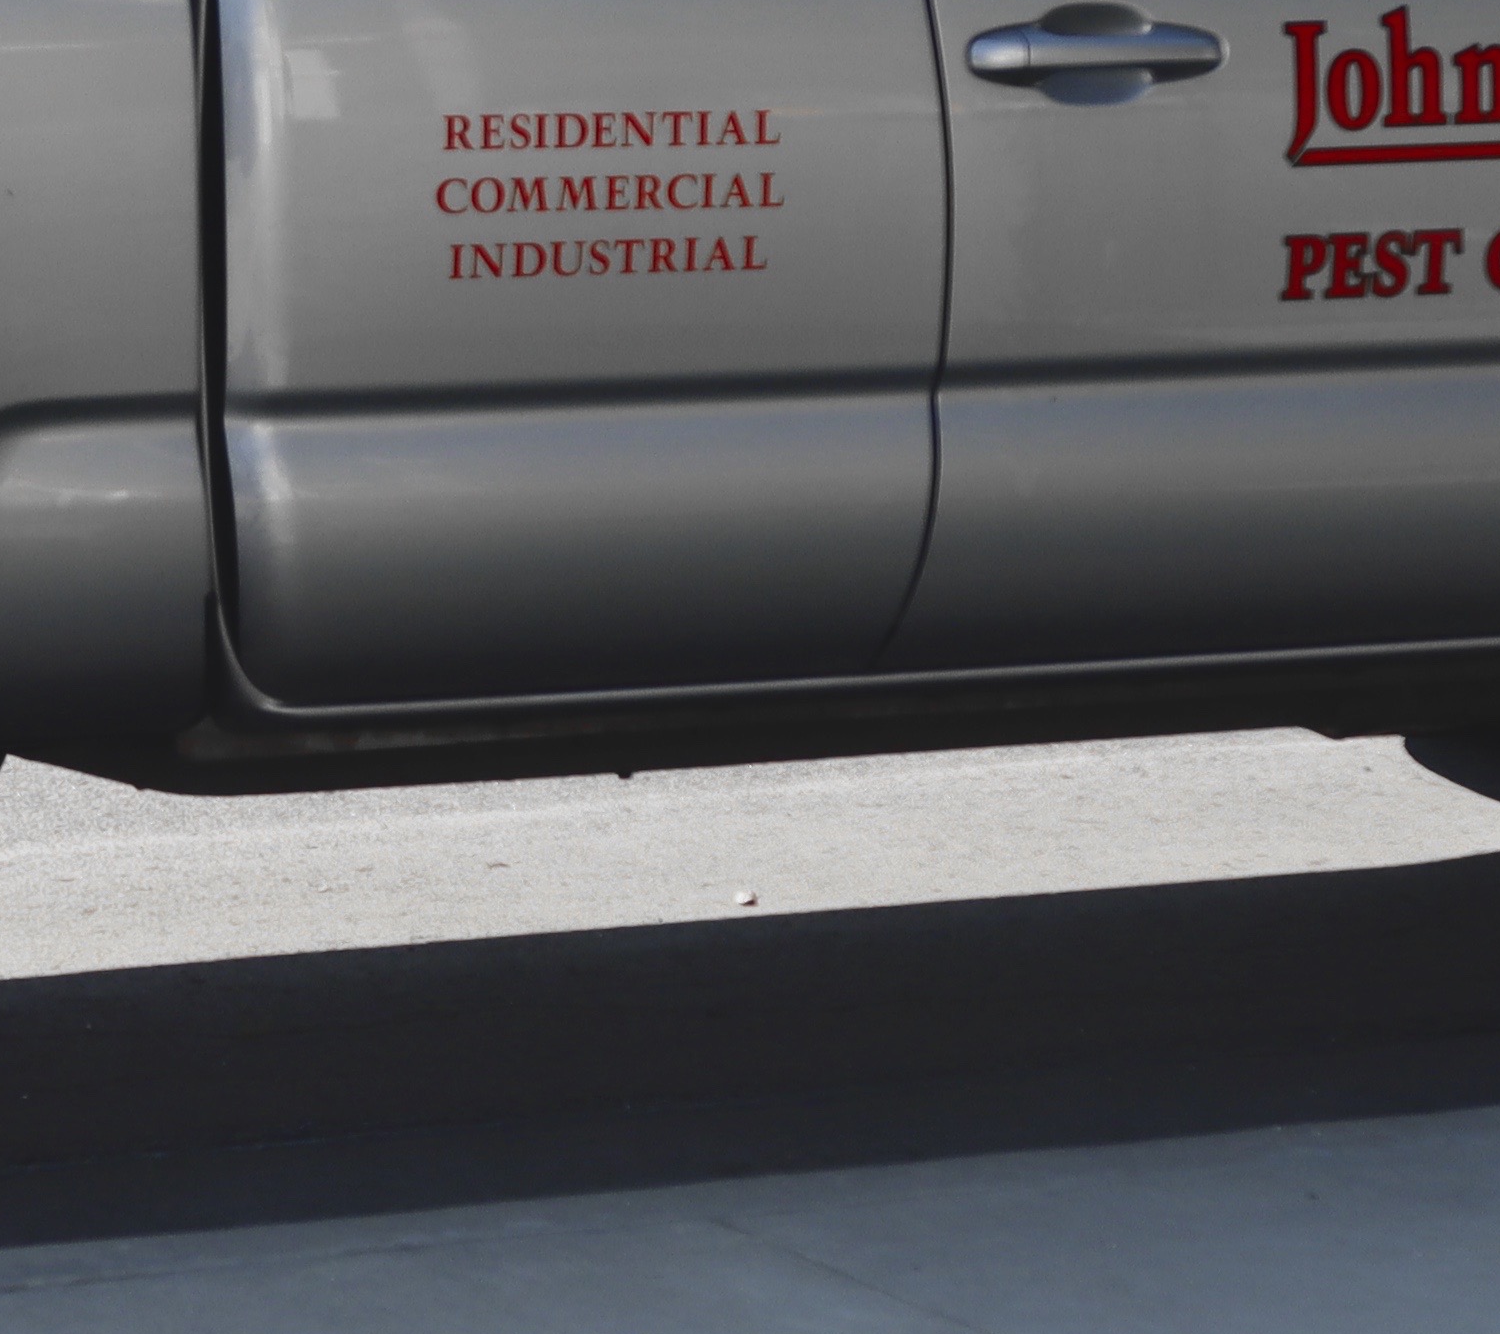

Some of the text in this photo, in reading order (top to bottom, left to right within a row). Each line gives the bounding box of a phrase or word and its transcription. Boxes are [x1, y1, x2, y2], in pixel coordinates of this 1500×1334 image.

[442, 108, 782, 151] RESIDENTIAL
[435, 172, 786, 215] COMMERCIAL
[448, 235, 769, 280] INDUSTRIAL
[1279, 227, 1463, 302] PEST
